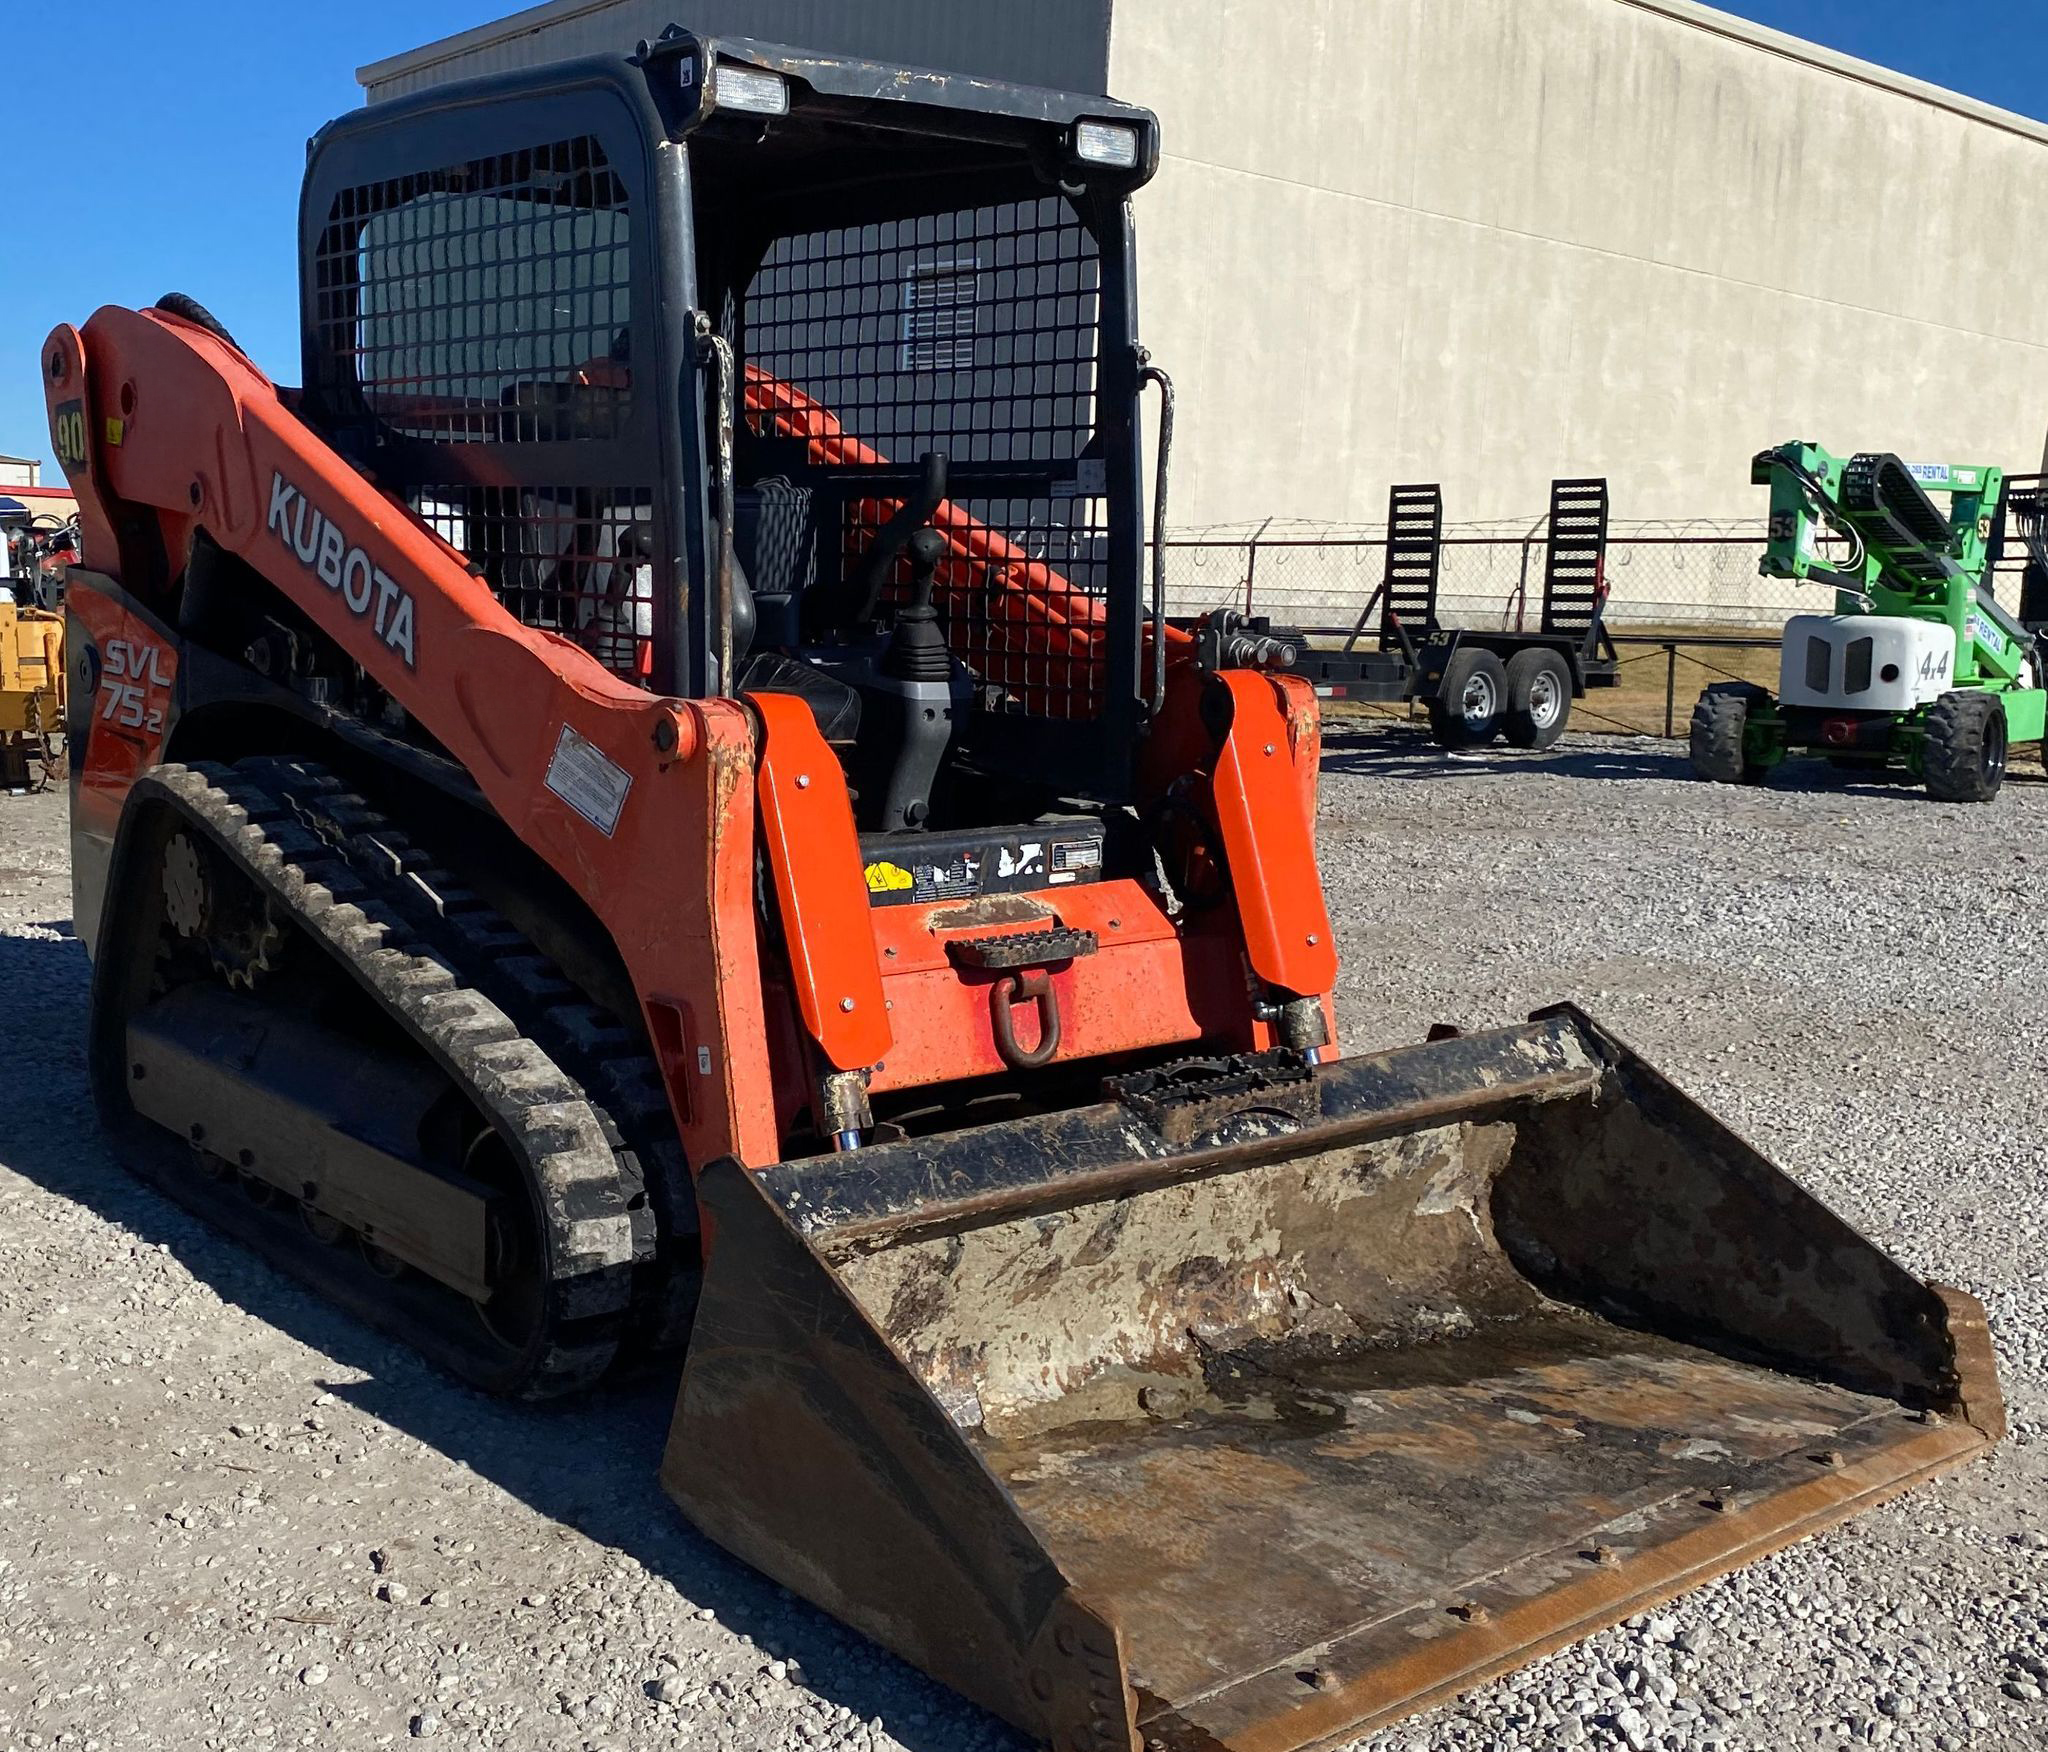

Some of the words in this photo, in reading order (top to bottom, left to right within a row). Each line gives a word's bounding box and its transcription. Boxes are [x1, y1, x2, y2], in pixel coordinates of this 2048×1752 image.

[1922, 465, 1948, 480] RENTAL
[1770, 516, 1796, 539] 53
[268, 471, 414, 666] KUBOTA
[1428, 632, 1450, 646] 53
[1979, 621, 2001, 652] RENTAL
[103, 639, 171, 688] SVL
